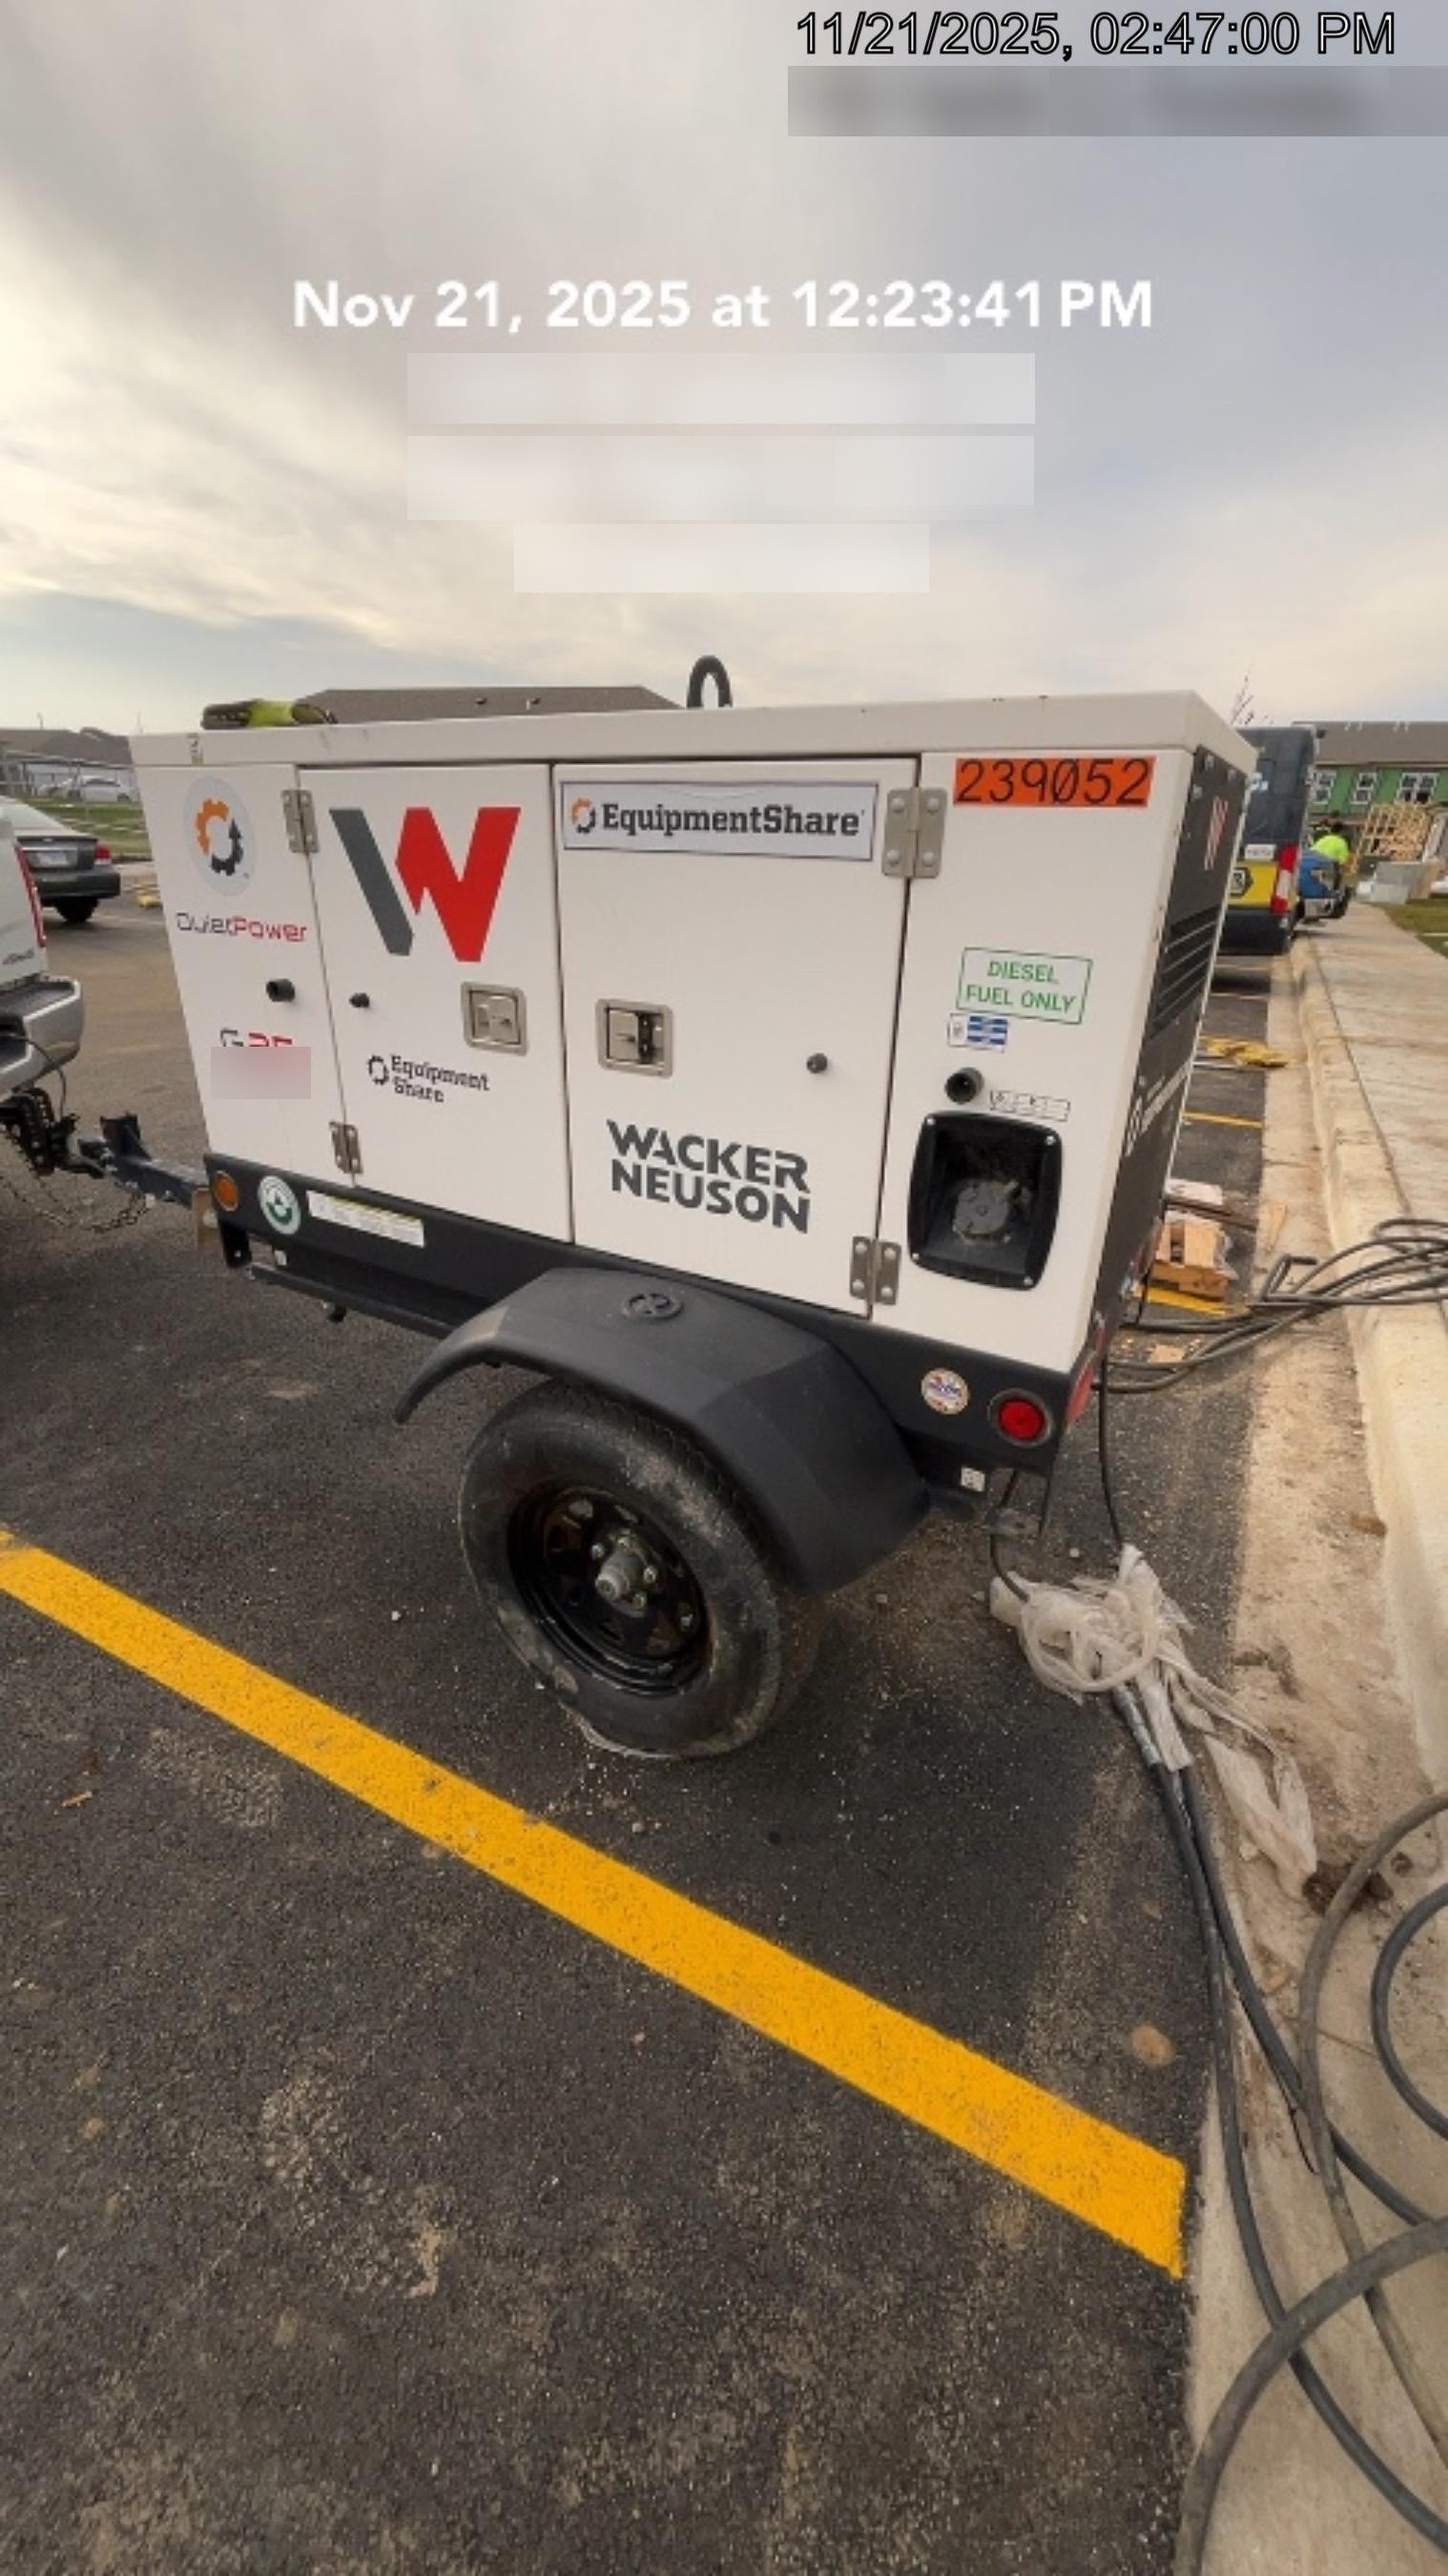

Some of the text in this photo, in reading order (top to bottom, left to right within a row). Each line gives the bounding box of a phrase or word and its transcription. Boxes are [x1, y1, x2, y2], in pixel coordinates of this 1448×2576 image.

[601, 803, 859, 837] EquipmentShare
[176, 911, 308, 943] QuietPower
[986, 960, 1059, 985] DIESEL
[965, 984, 1076, 1013] FUEL ONLY
[391, 1053, 490, 1091] Equipment
[393, 1075, 445, 1103] Share
[606, 1118, 810, 1194] WACKER
[611, 1158, 810, 1235] NEUSON
